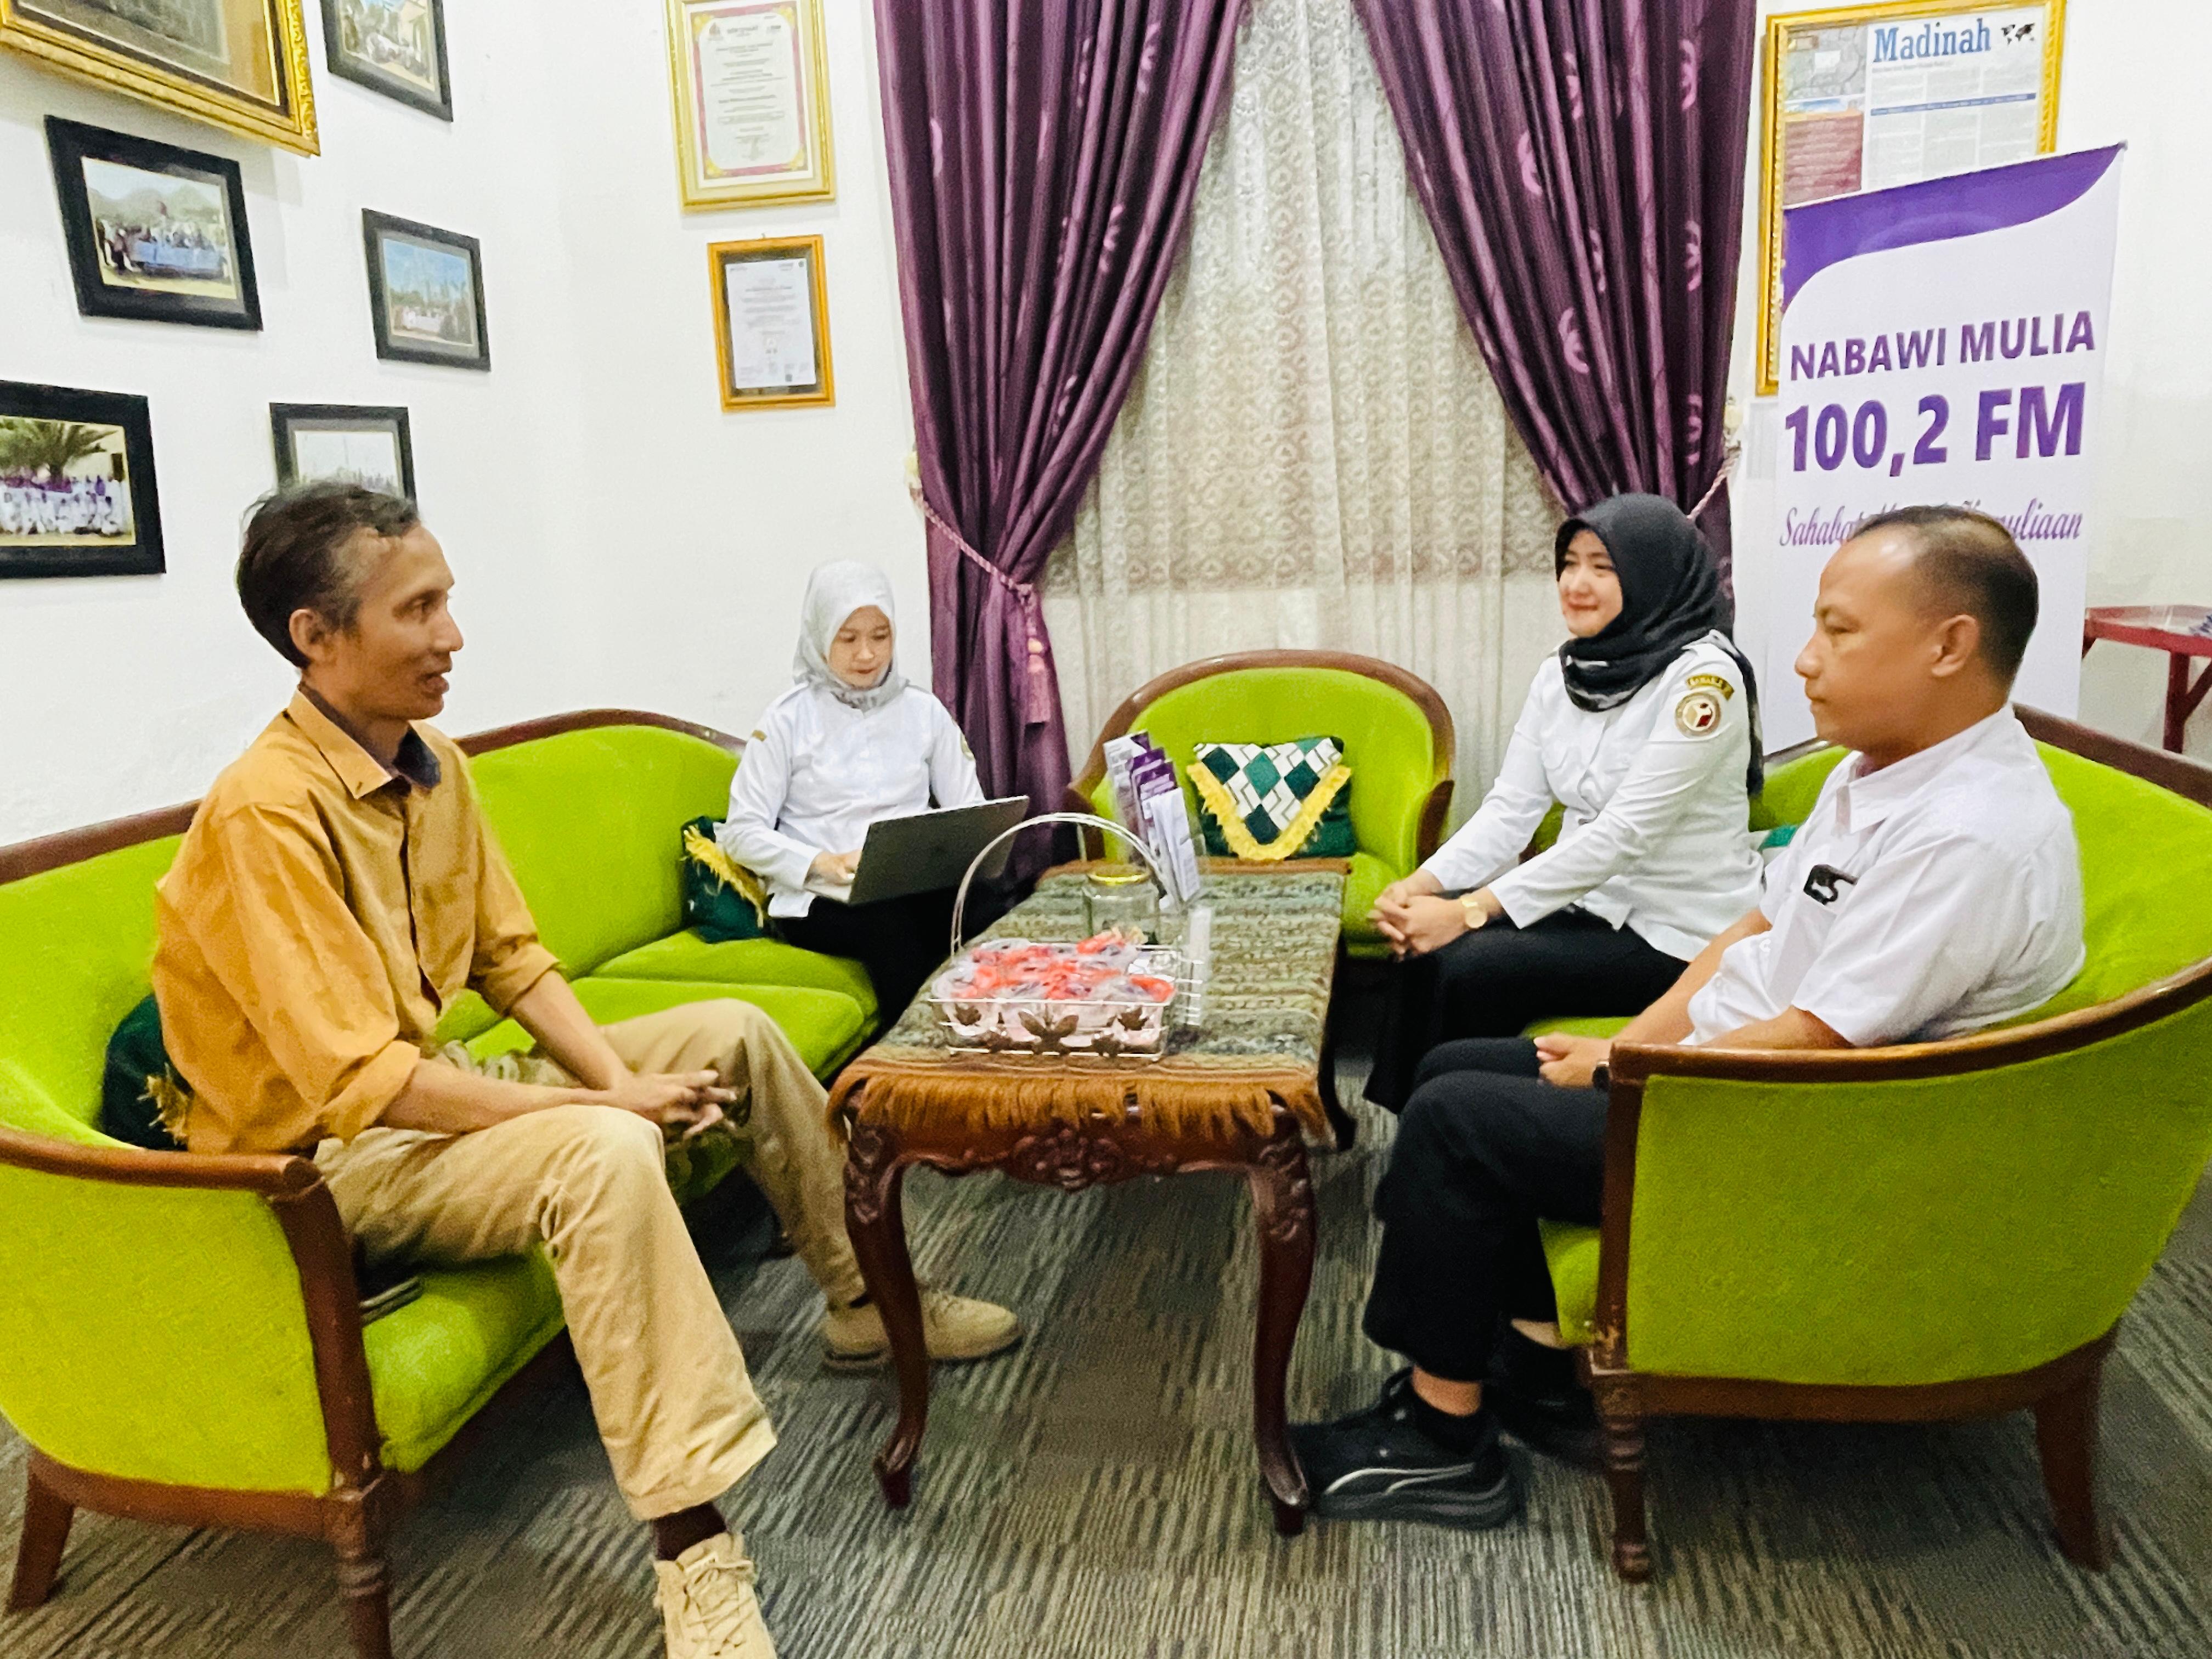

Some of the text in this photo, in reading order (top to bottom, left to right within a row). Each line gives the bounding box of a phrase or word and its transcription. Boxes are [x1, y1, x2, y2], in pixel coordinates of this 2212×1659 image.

[1872, 18, 1991, 63] Madinah
[1790, 310, 2096, 381] NABAWI MULIA
[1785, 381, 2086, 477] 100,2 FM
